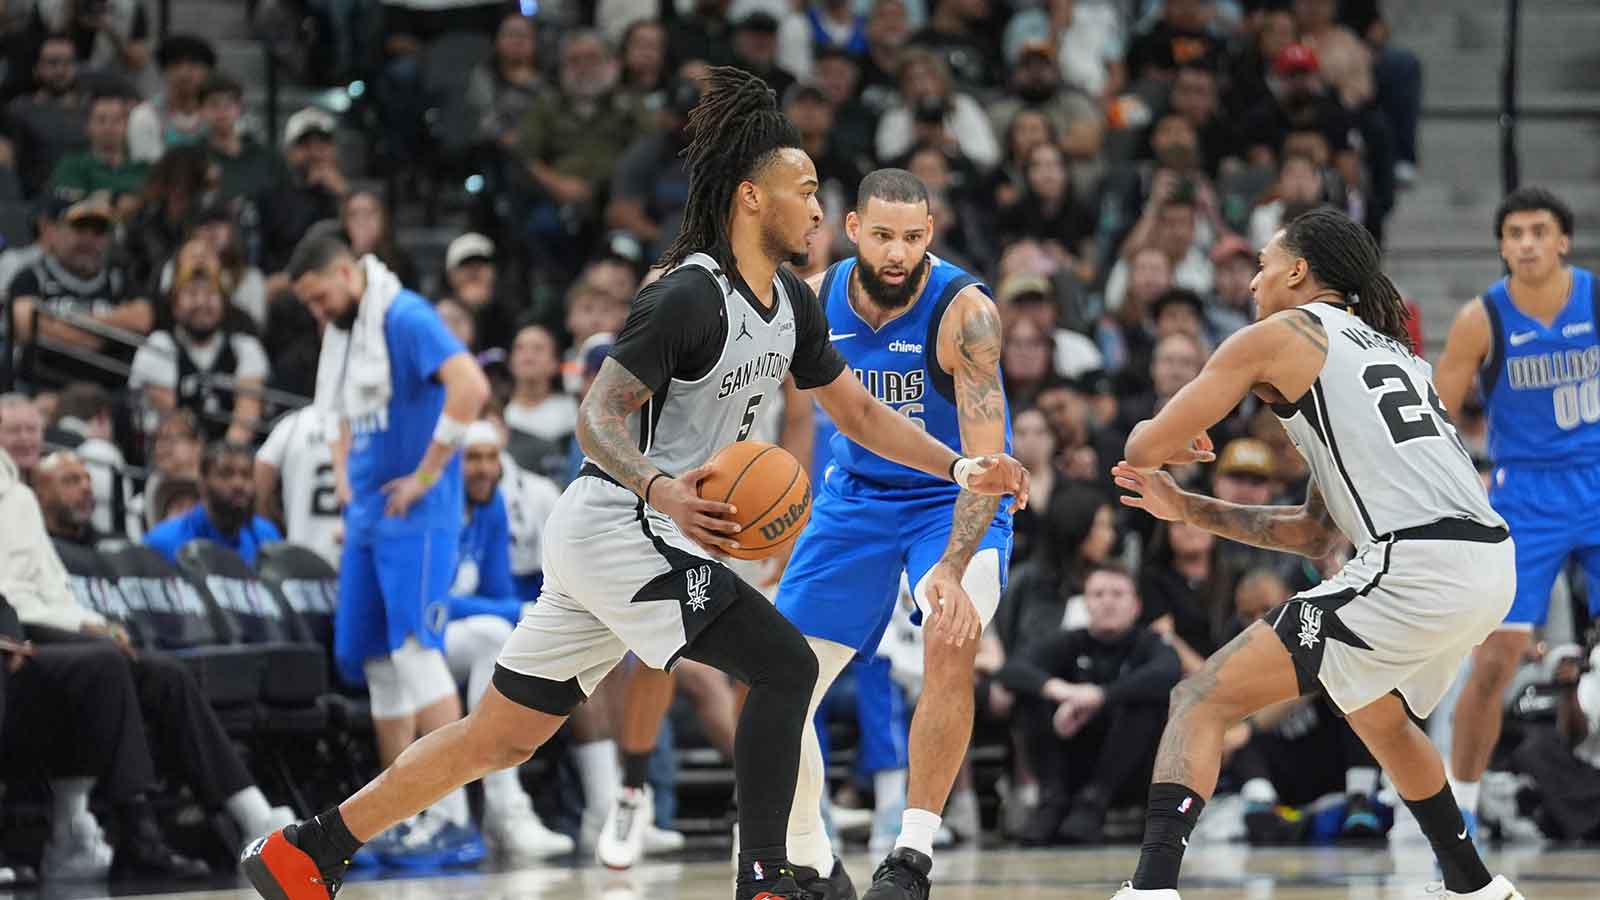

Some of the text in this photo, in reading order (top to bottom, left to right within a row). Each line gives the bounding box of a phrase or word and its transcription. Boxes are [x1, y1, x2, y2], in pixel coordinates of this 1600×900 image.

[889, 340, 922, 353] chime
[1507, 345, 1600, 391] DALLAS
[717, 359, 754, 400] SAN
[735, 392, 764, 442] 5
[1552, 379, 1600, 431] 00
